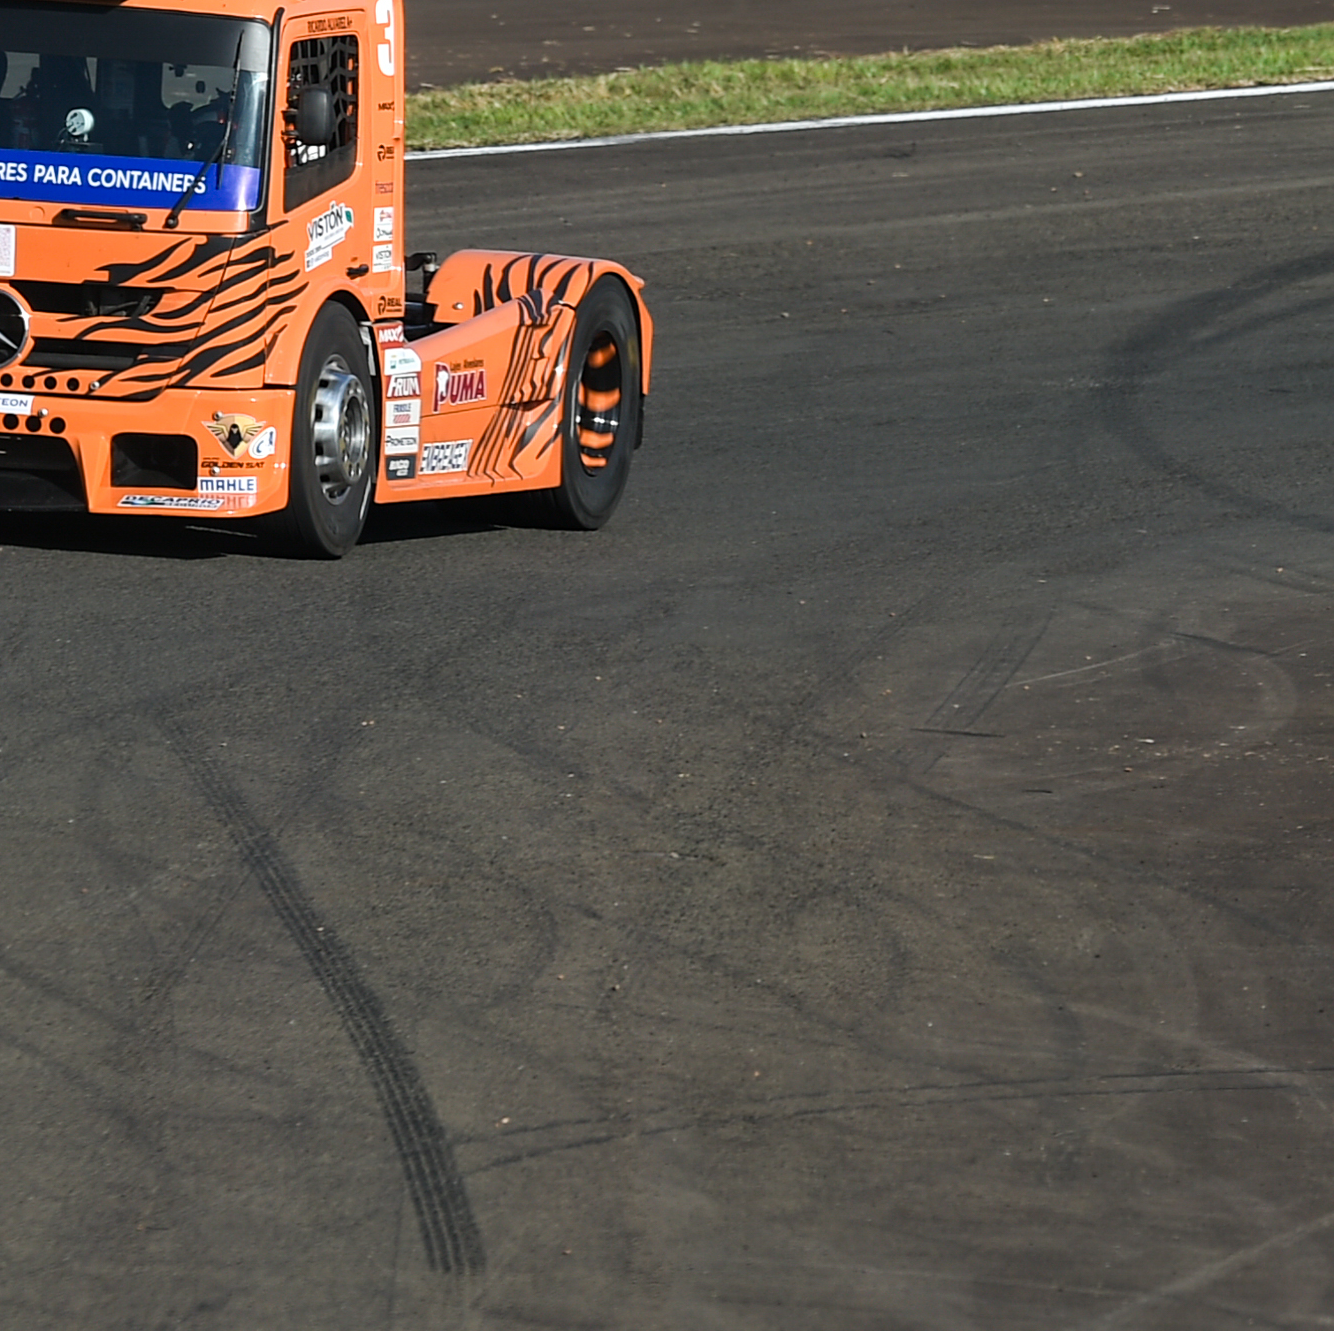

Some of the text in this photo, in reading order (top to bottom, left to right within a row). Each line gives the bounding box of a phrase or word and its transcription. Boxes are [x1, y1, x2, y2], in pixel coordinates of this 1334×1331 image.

[33, 167, 82, 187] PARA
[386, 297, 403, 307] REAL
[386, 373, 420, 398] FRUM
[432, 362, 487, 414] PUMA
[200, 460, 265, 469] GOLDEN SAT
[199, 478, 255, 491] MAHLE
[124, 495, 221, 506] DECAPRIO
